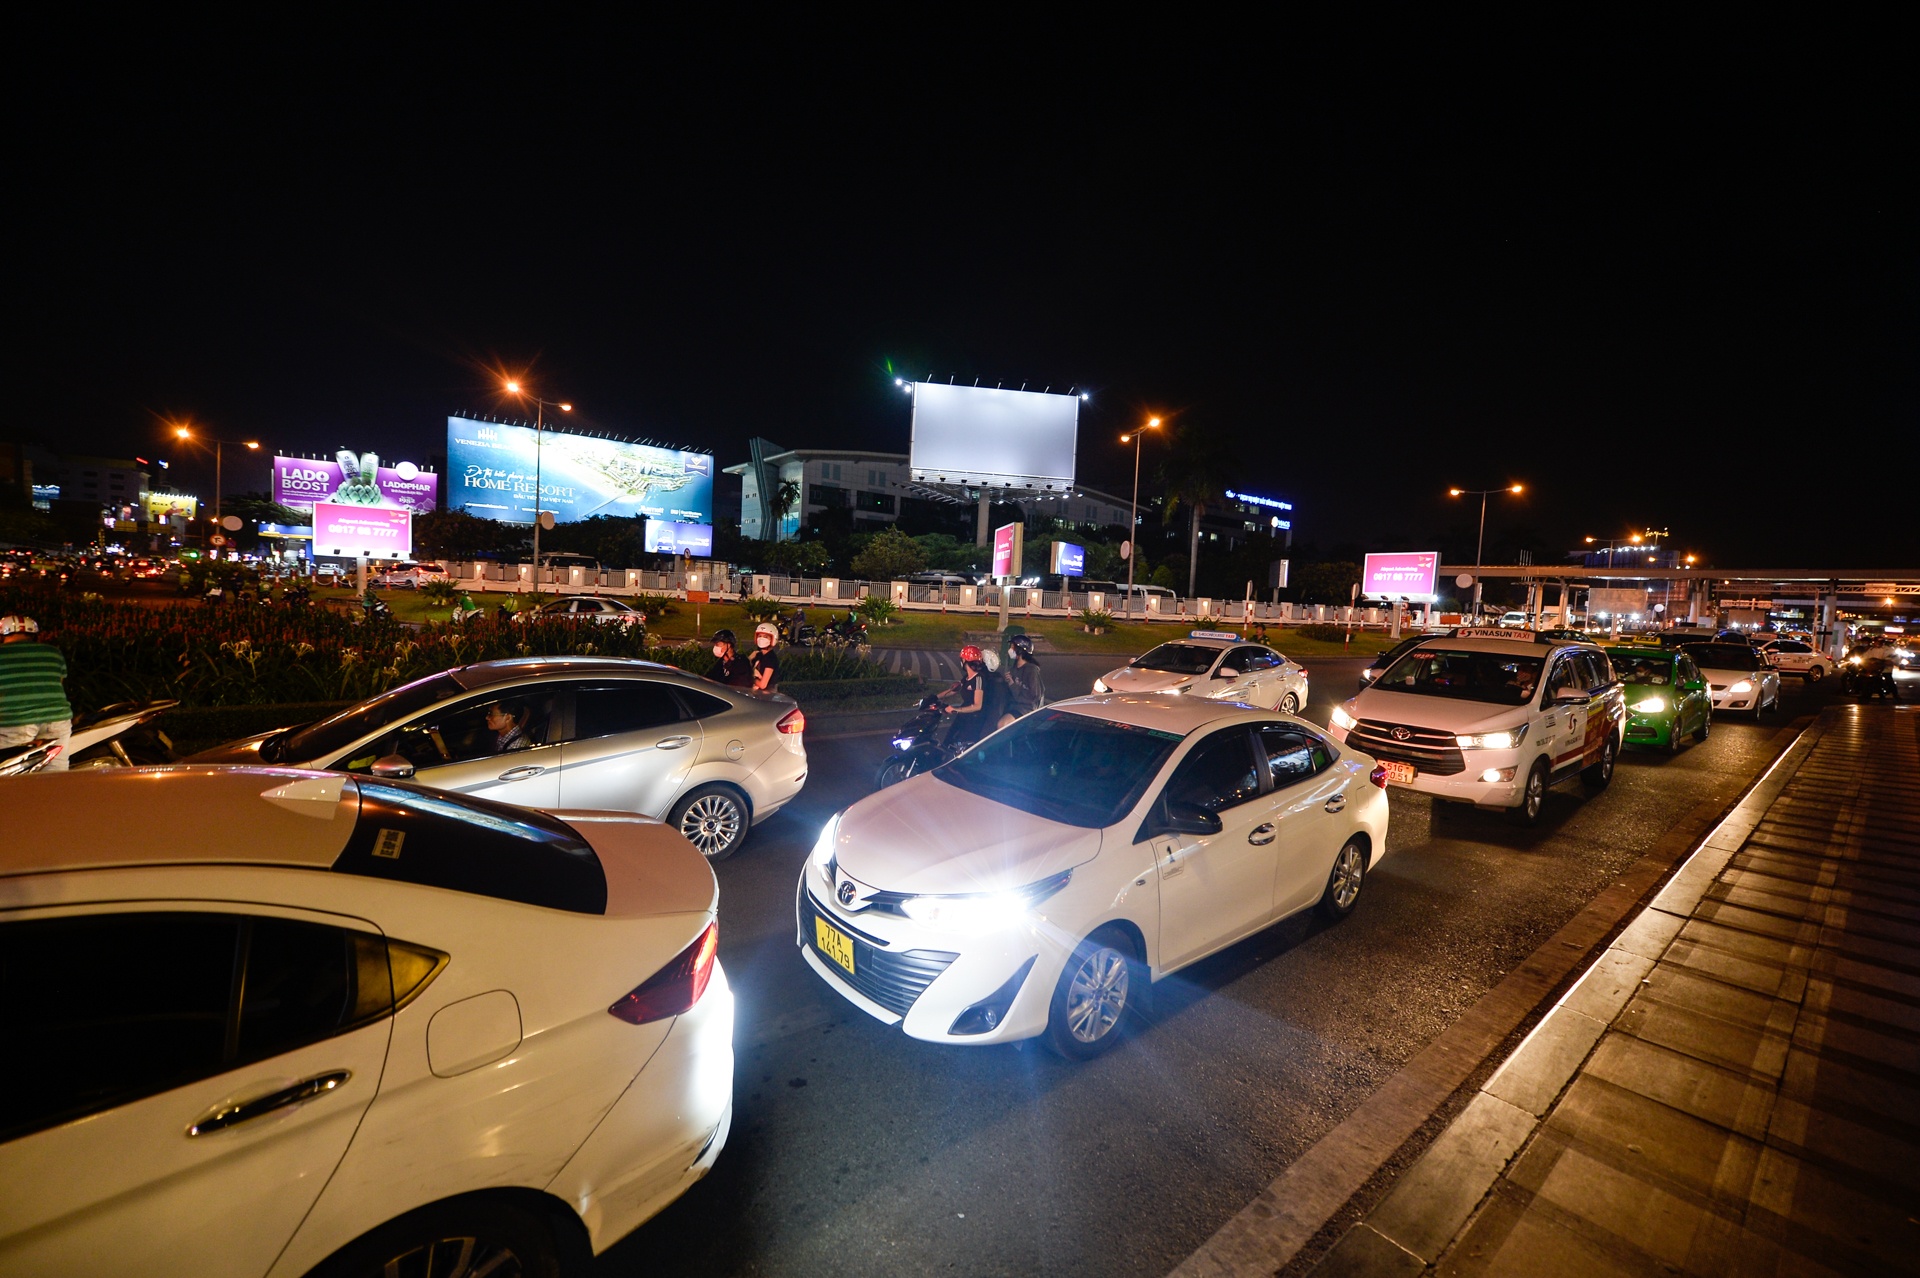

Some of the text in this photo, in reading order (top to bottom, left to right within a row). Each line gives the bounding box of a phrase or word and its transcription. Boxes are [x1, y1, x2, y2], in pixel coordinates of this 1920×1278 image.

[282, 467, 330, 482] LADO
[282, 479, 330, 492] BOOST
[383, 481, 431, 491] LADOPHAR
[464, 476, 576, 498] HOME RESORT
[372, 528, 399, 538] 7777
[1404, 573, 1425, 582] 7777
[1475, 629, 1531, 639] VINASUN TAXI
[1387, 763, 1404, 773] 51G
[1388, 771, 1408, 783] 0.51
[825, 925, 842, 949] 77A
[822, 937, 850, 969] 141.79
